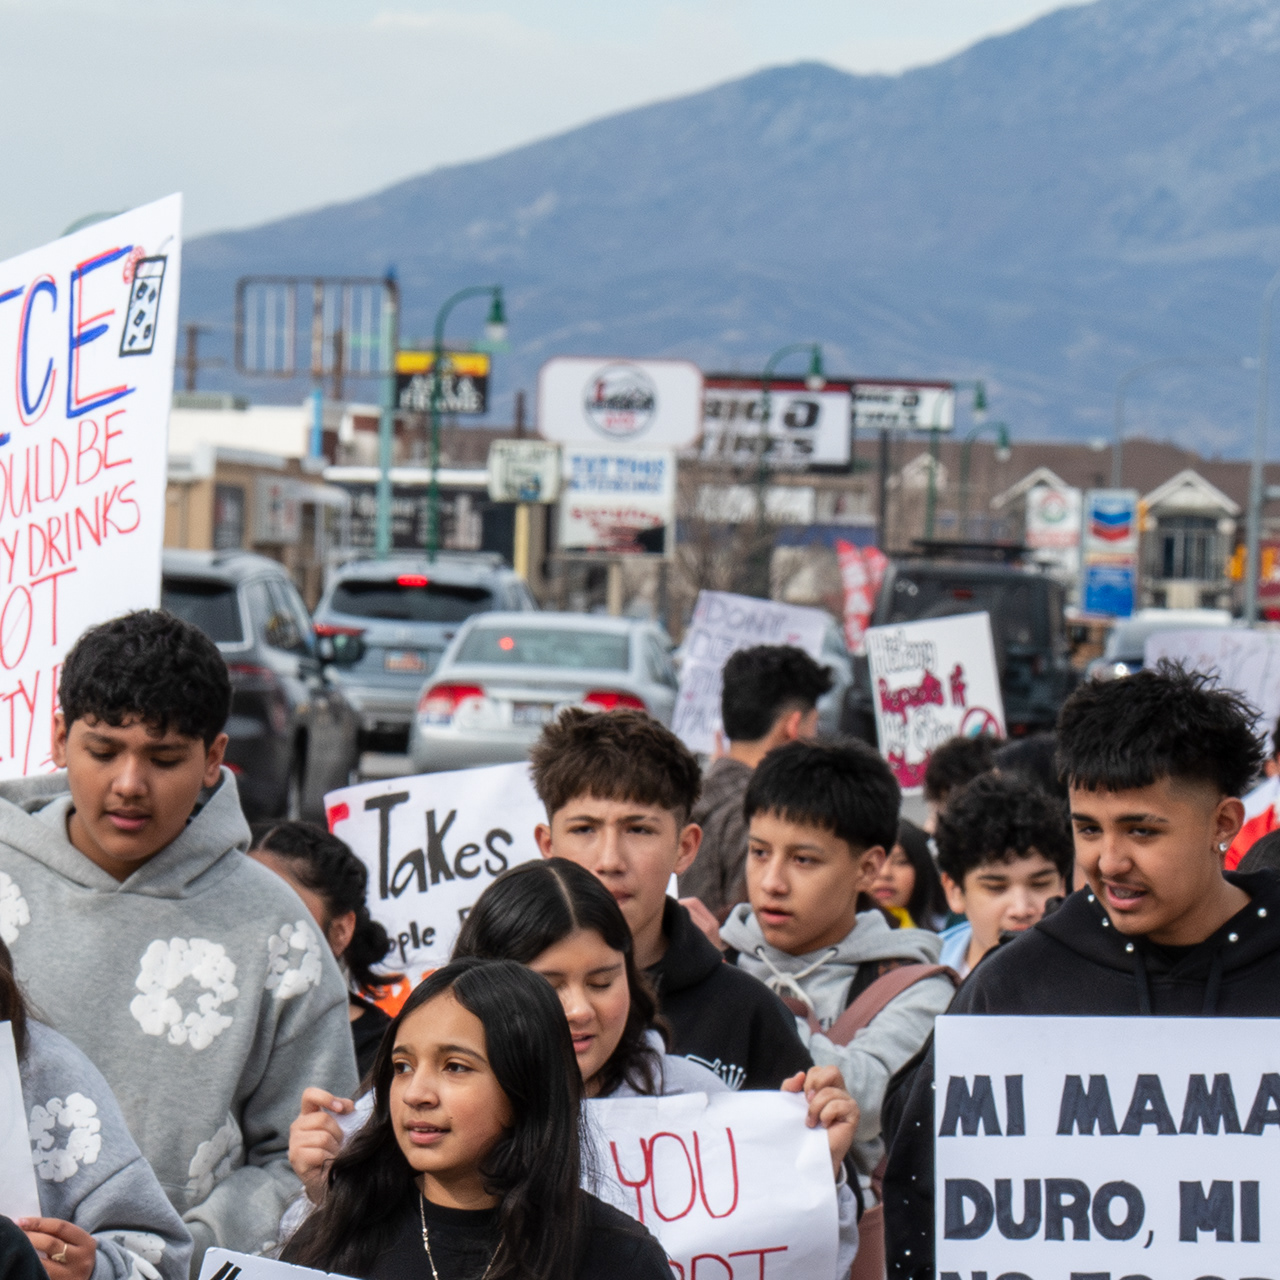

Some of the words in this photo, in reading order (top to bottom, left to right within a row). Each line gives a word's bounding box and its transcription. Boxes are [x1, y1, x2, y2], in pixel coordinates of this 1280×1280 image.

[75, 409, 133, 486] BE
[28, 481, 141, 577] DRINKS
[363, 791, 514, 900] Takes
[938, 1074, 1026, 1137] MI
[609, 1126, 740, 1224] YOU
[942, 1177, 1155, 1250] DURO,
[1178, 1180, 1261, 1244] MI
